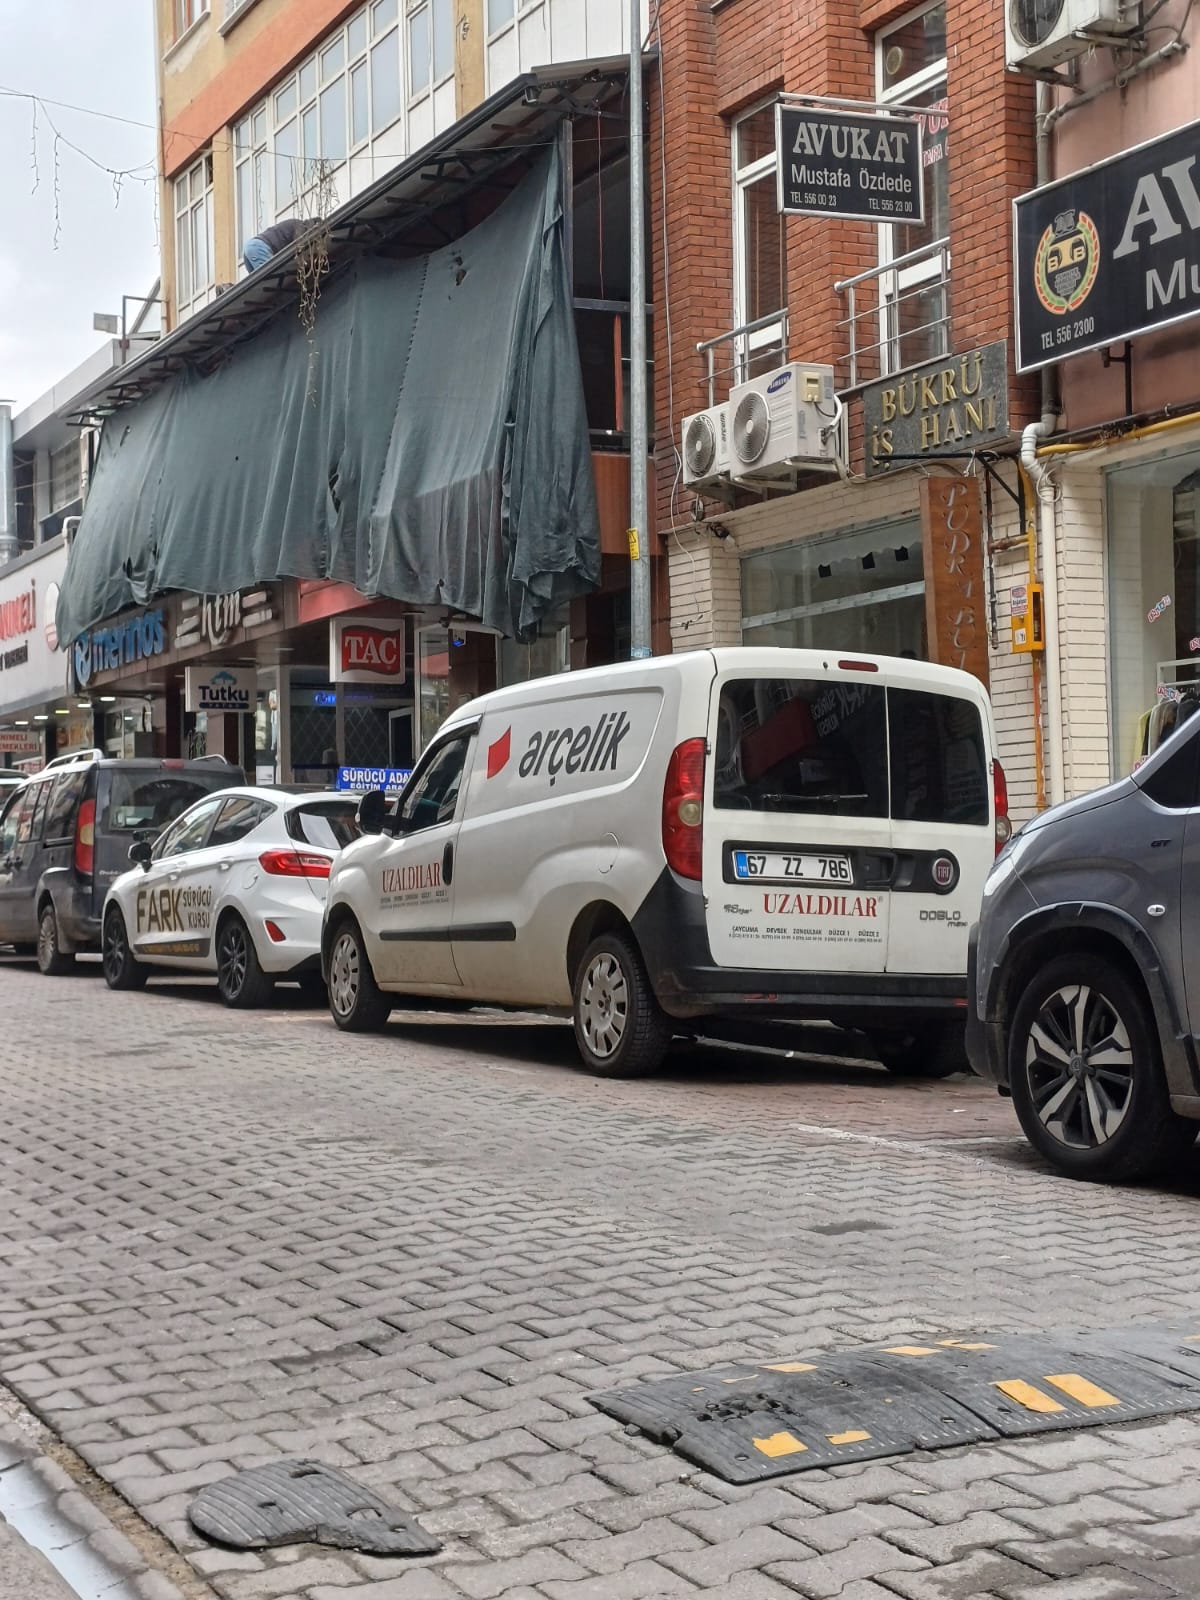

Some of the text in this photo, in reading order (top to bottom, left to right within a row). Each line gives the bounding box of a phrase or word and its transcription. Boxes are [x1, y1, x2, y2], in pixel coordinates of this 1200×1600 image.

[792, 121, 910, 164] AVUKAT
[791, 163, 912, 193] Mustafa Özdede
[790, 191, 837, 206] TEL 556 00 23
[868, 198, 913, 213] TEL 556 23 00
[1041, 316, 1095, 350] TEL 556 2300
[881, 351, 984, 423] BÜKRÜ
[93, 609, 164, 673] merinos
[198, 685, 249, 702] Tutku
[518, 711, 631, 786] arçelik
[342, 769, 386, 783] SÜRÜCÜ
[350, 782, 381, 791] EĞİTİM
[381, 862, 441, 893] UZALDILAR
[747, 855, 767, 874] 67
[782, 856, 804, 877] ZZ
[818, 858, 849, 879] 786
[136, 885, 212, 933] FARK SÜRÜCÜ
[762, 893, 878, 918] UZALDILAR
[919, 909, 961, 921] DOBLO
[188, 911, 210, 929] KURSU
